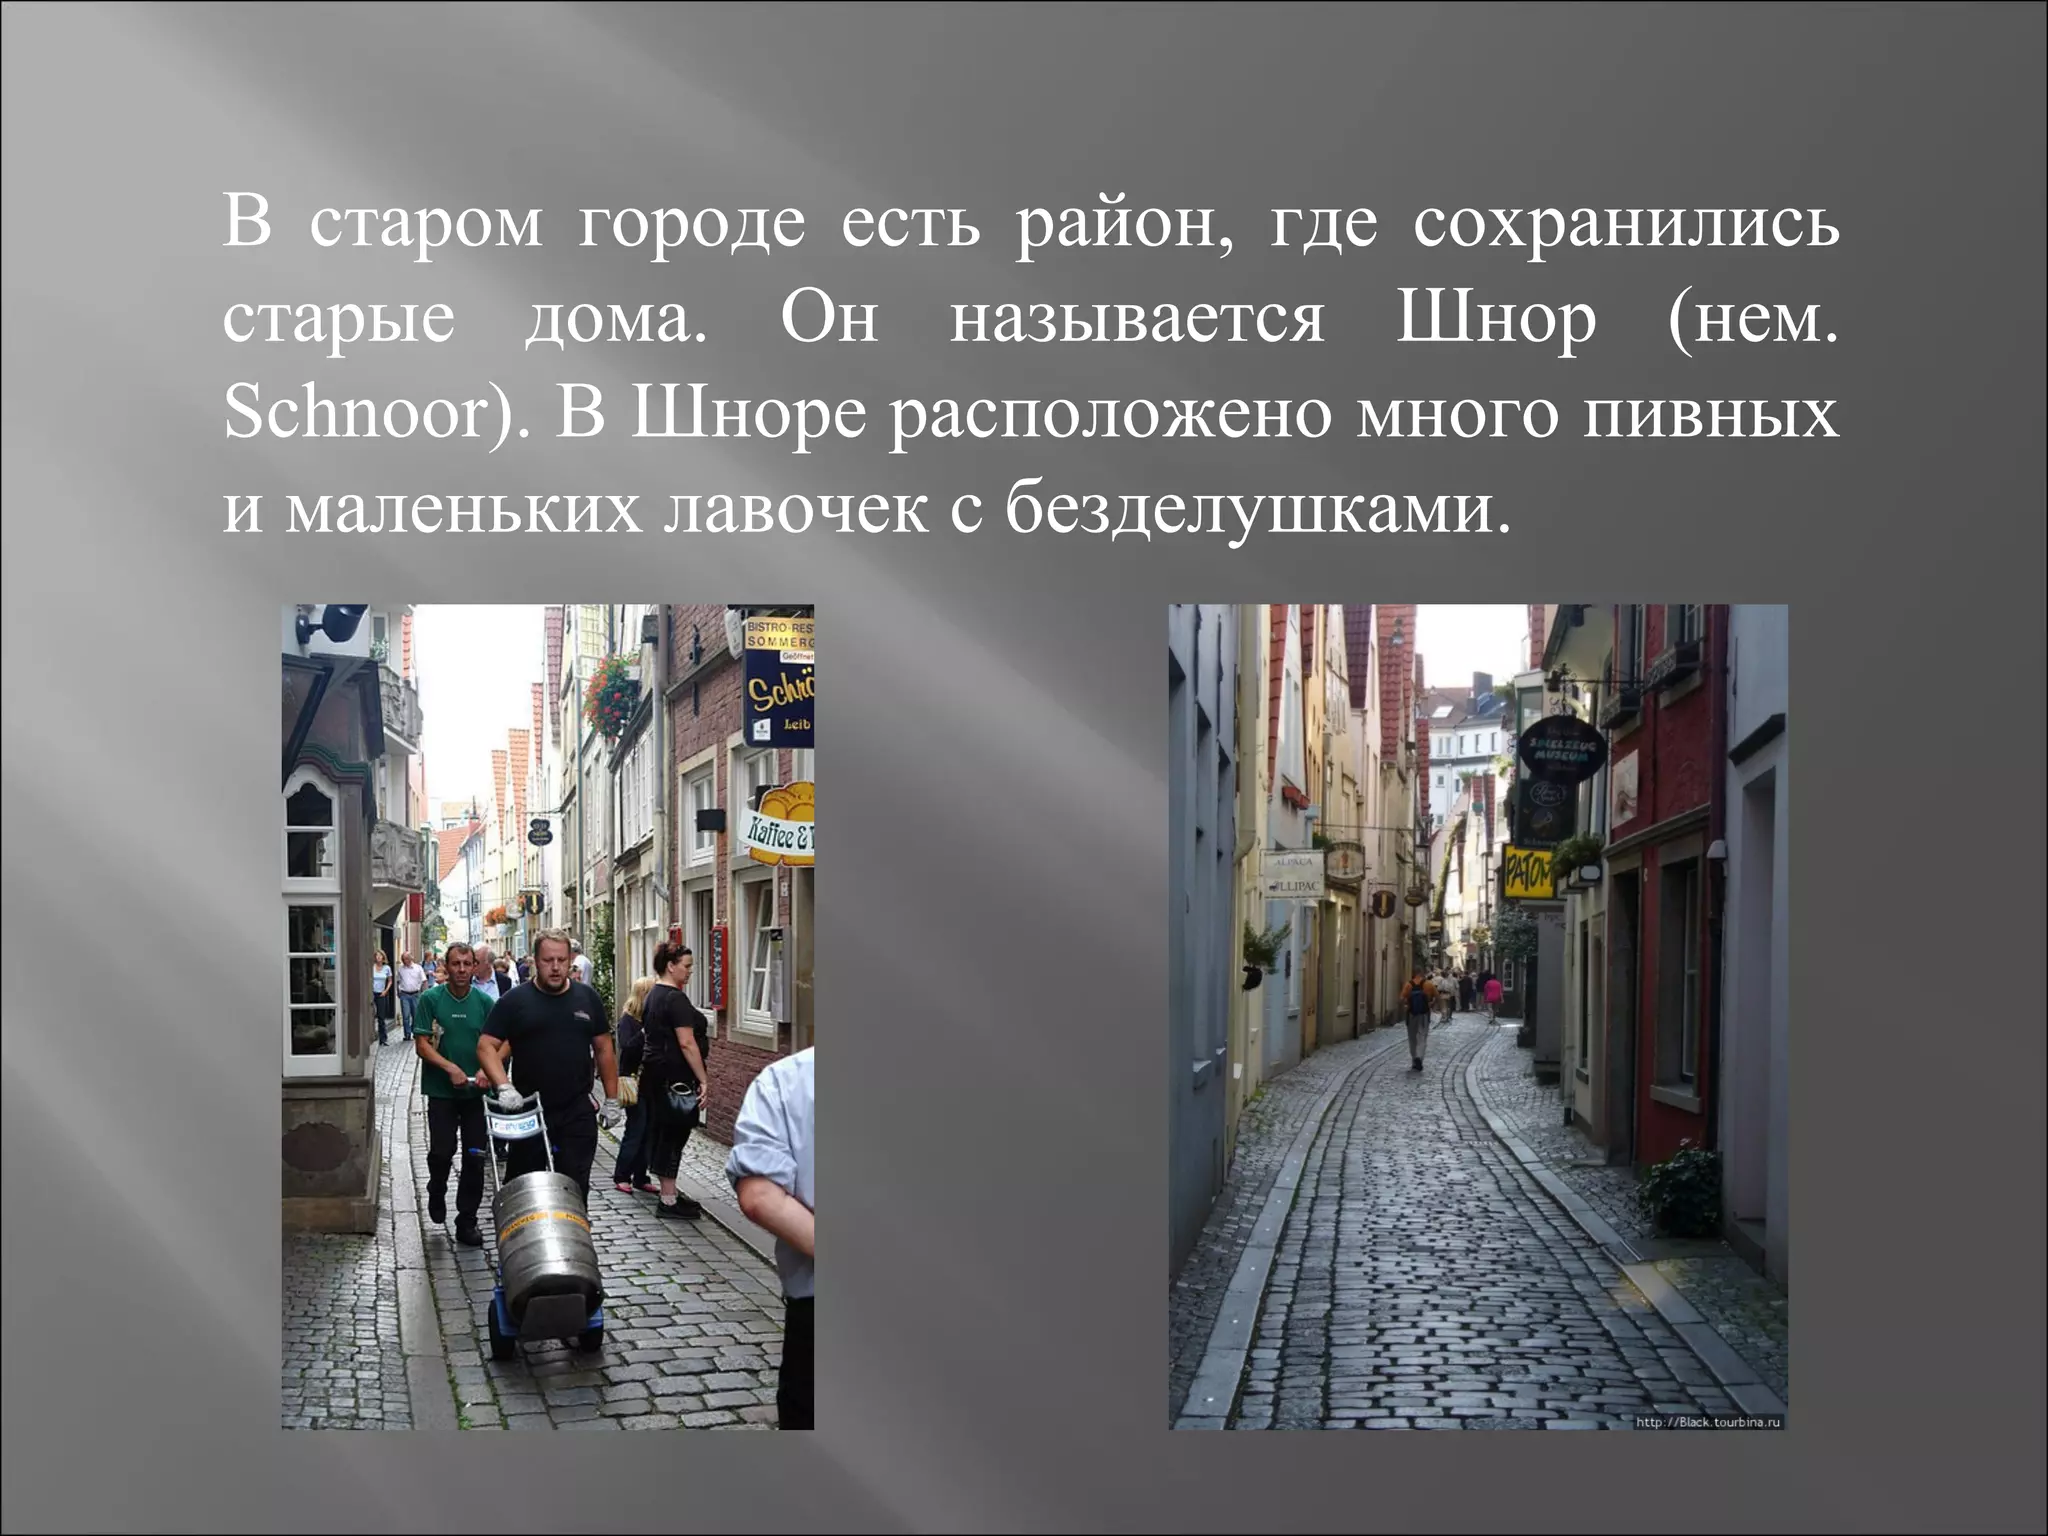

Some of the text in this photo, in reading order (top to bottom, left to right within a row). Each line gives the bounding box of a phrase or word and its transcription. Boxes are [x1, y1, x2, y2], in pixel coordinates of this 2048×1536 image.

[784, 719, 811, 730] Leib
[1534, 750, 1589, 762] MUSEUM
[747, 816, 808, 850] Kaffee &
[1275, 858, 1313, 867] ALPACA
